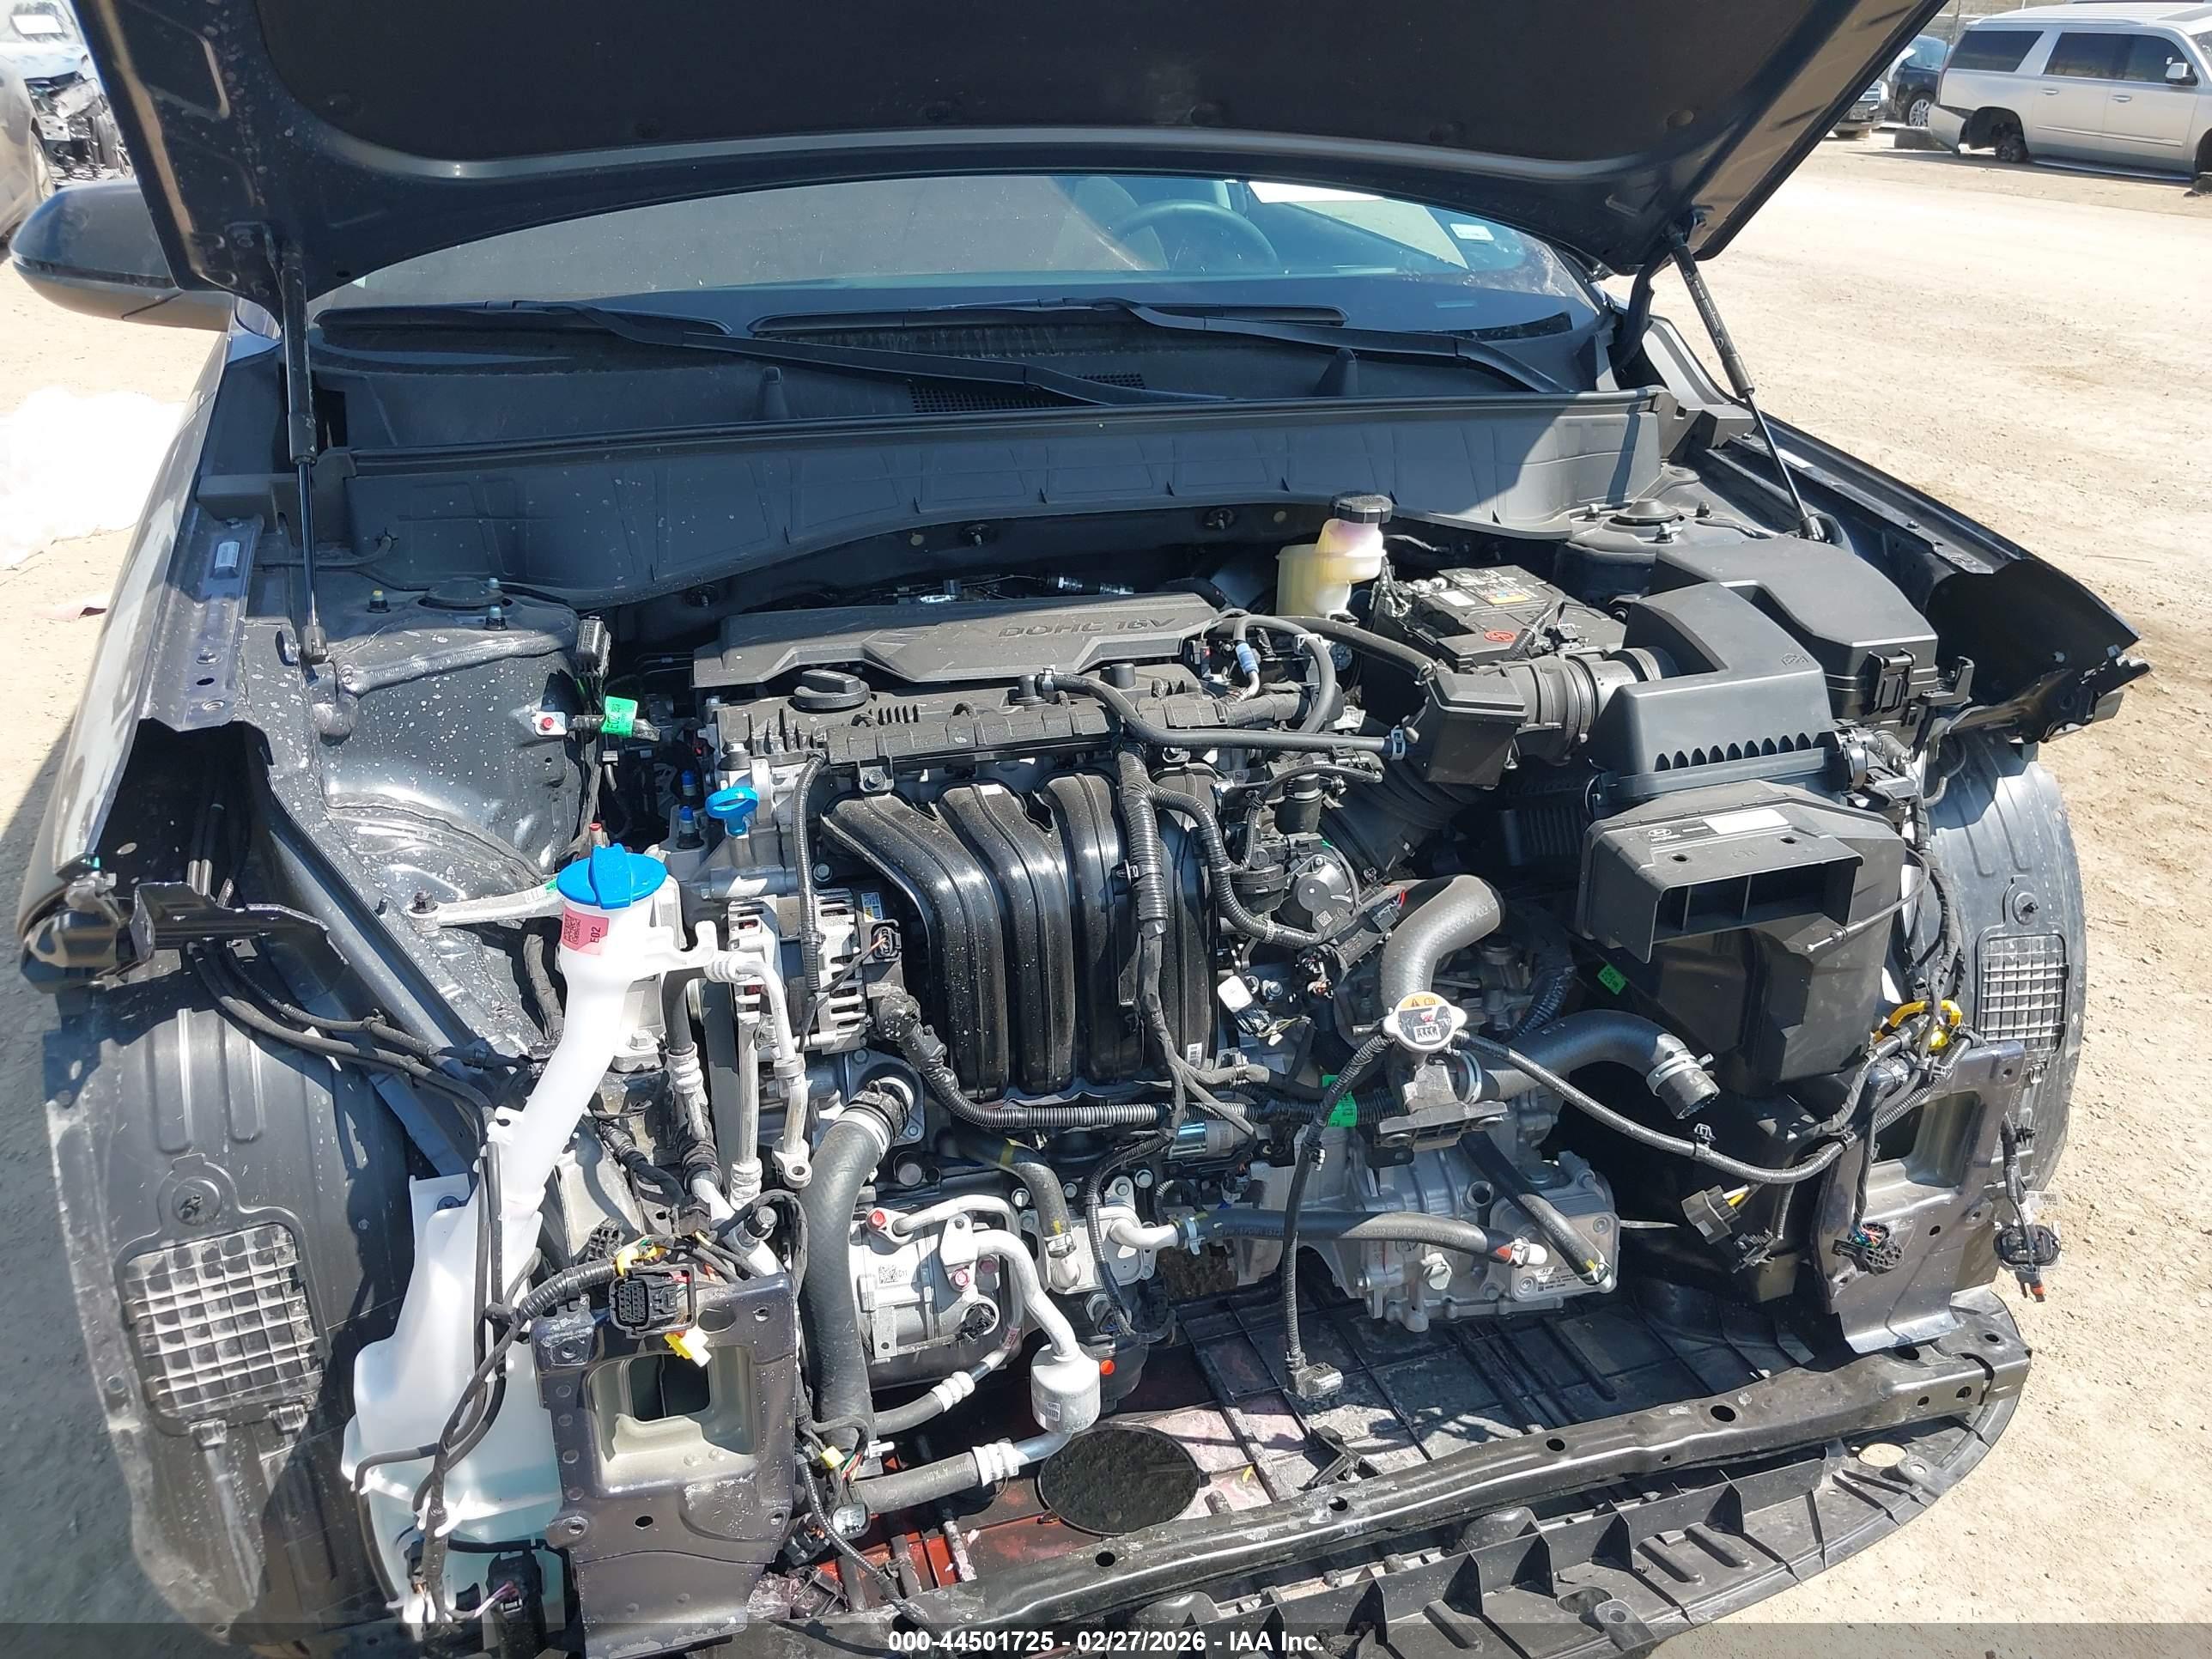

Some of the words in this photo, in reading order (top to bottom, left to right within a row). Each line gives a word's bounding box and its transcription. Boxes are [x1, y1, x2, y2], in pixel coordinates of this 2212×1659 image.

[998, 621, 1105, 639] DOHC
[1116, 617, 1176, 631] 16V
[590, 927, 602, 944] E02
